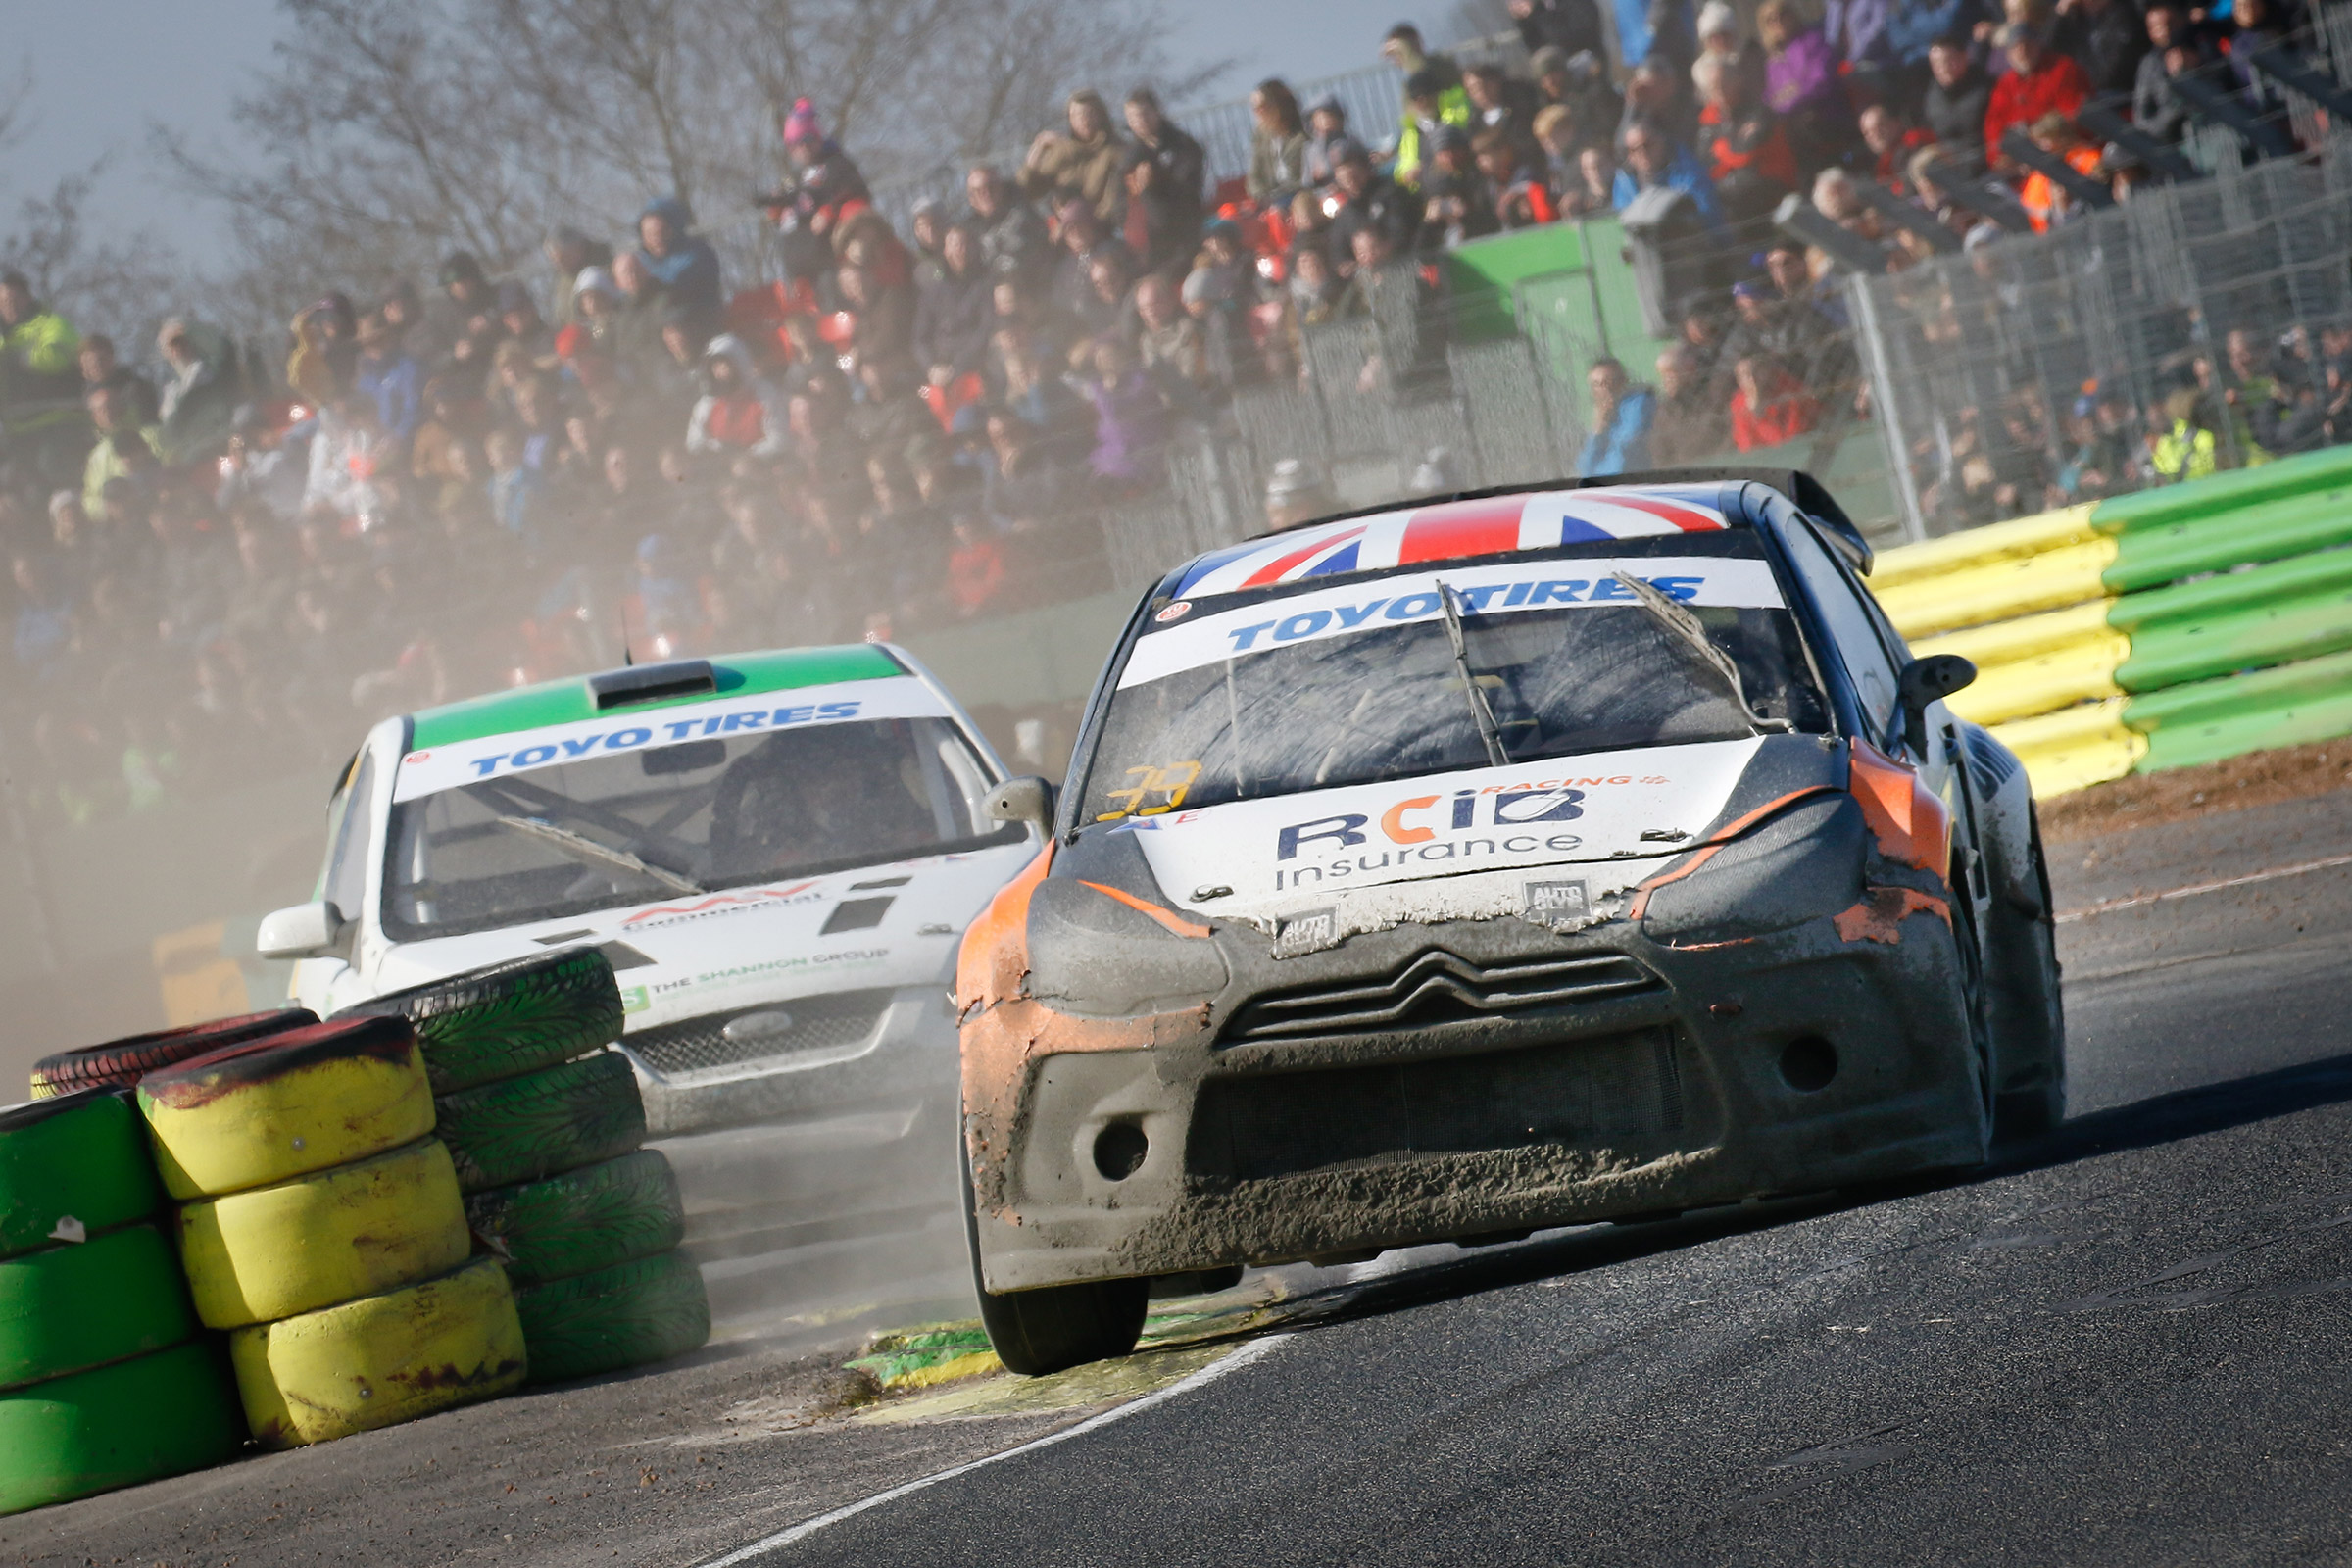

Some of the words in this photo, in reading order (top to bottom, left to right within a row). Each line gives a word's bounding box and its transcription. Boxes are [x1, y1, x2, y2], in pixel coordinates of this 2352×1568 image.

[1227, 591, 1444, 651] TOYO
[1459, 576, 1706, 613] TIRES
[469, 727, 654, 777] TOYO
[664, 701, 862, 740] TIRES
[1480, 775, 1632, 795] RACING
[1275, 834, 1583, 891] Insurance
[652, 977, 691, 994] THE
[698, 957, 808, 982] SHANNON
[812, 949, 890, 965] GROUP
